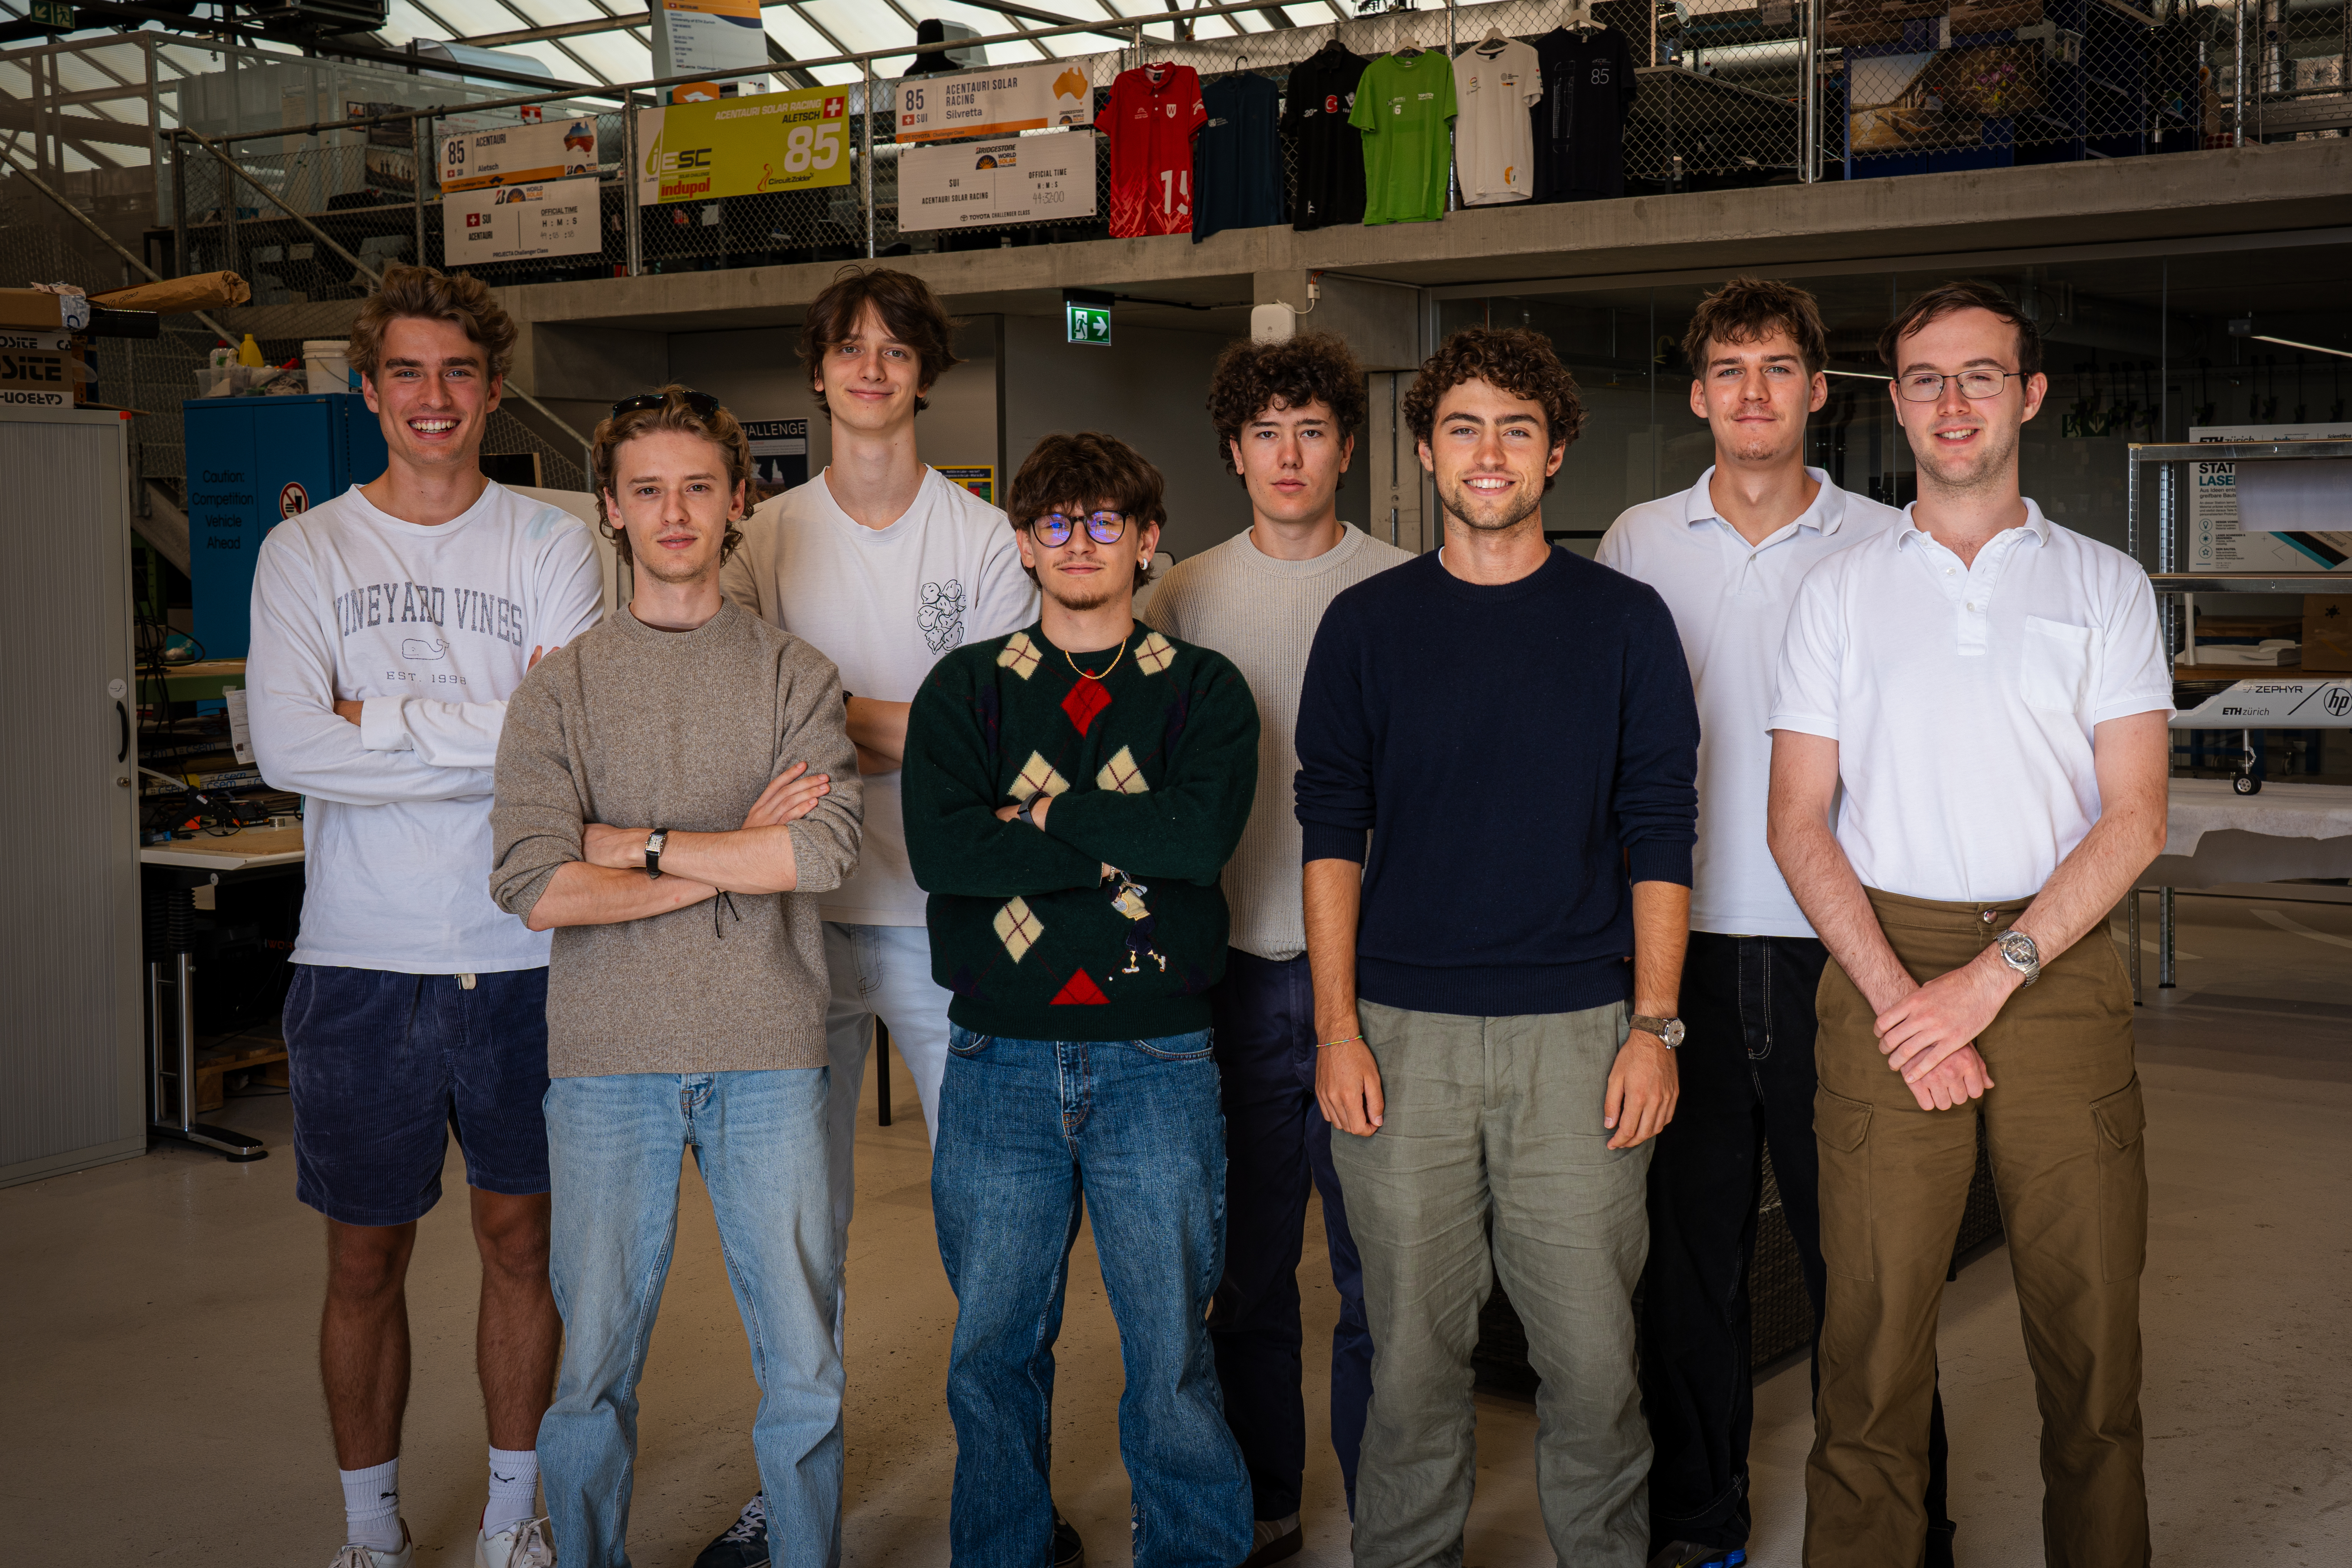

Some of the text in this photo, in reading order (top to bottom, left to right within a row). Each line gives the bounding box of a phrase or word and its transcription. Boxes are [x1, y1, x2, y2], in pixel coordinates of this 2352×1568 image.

[1591, 69, 1609, 84] 85
[946, 77, 1017, 95] ACENTAURI SOLAR
[906, 88, 924, 111] 85
[946, 94, 974, 107] RACING
[715, 98, 822, 120] ACENTAURI SOLAR RACING
[946, 108, 982, 119] Silvretta
[1168, 106, 1176, 115] W
[782, 111, 820, 124] ALETSCH
[916, 113, 927, 123] SUI
[476, 134, 506, 147] ACENTAURI
[448, 140, 464, 165] 85
[783, 122, 842, 173] 85
[975, 144, 1016, 154] BRIDGESTONE
[478, 163, 499, 172] Aletsch
[1029, 170, 1052, 178] OFFICIAL
[661, 177, 710, 198] indupol
[949, 179, 959, 187] SUI
[922, 195, 950, 204] ACENTAURI
[952, 194, 968, 202] SOLAR
[483, 214, 491, 224] SUI
[468, 231, 493, 241] ACENTAURI
[203, 470, 245, 483] Caution:
[2199, 475, 2235, 486] LASE
[192, 492, 254, 508] Competition
[205, 514, 242, 527] Vehicle
[207, 536, 241, 549] Ahead
[334, 581, 522, 647] VINEYARD VINES
[386, 671, 467, 685] EST. 1998
[2327, 688, 2350, 716] hp
[2242, 707, 2269, 715] zürich
[186, 742, 216, 753] csem
[207, 780, 236, 790] csem
